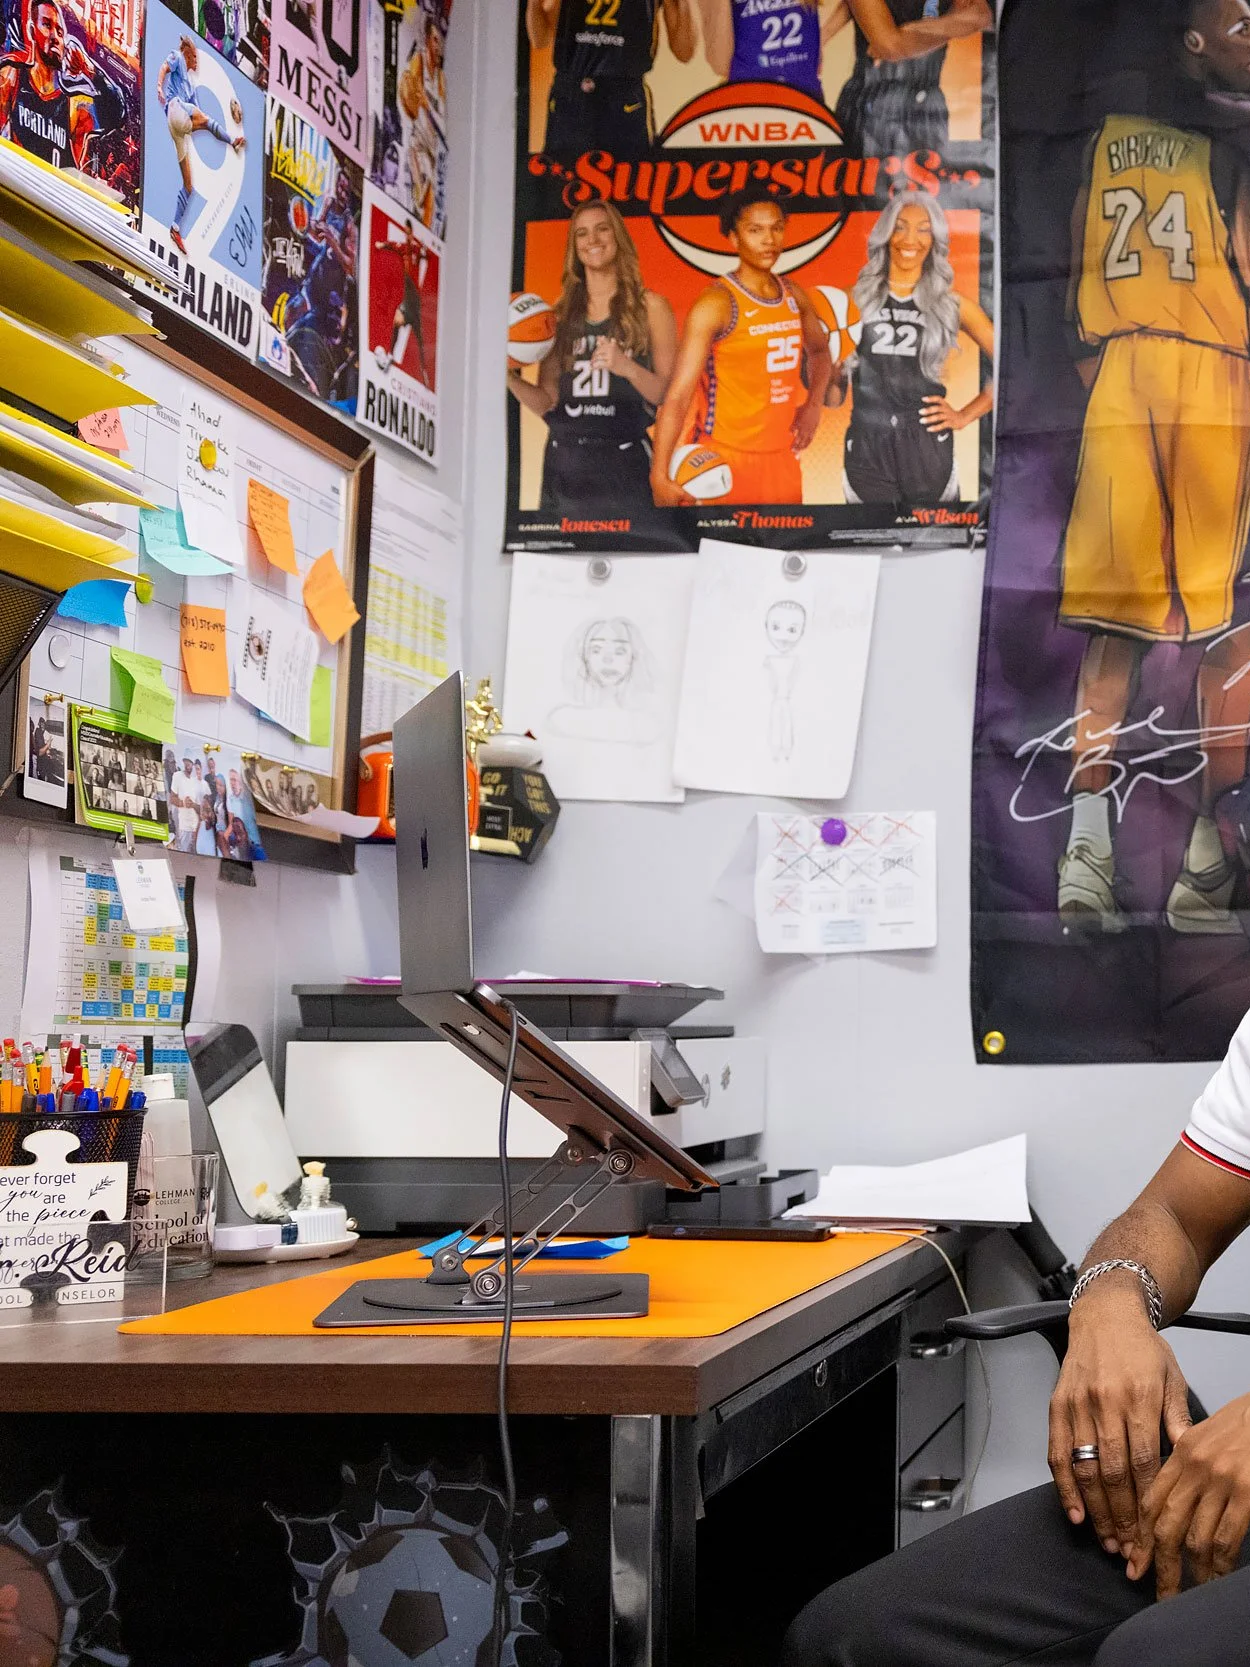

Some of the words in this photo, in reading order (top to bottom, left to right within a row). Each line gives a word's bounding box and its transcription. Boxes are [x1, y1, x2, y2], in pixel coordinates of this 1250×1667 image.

[584, 0, 619, 26] 22
[761, 12, 803, 51] 22
[277, 44, 362, 151] MESSI
[18, 104, 67, 150] PORTLAND
[699, 121, 817, 143] WNBA
[562, 149, 942, 216] Superstars
[1102, 187, 1196, 282] 24
[870, 322, 918, 357] 22
[766, 335, 800, 374] 25
[364, 379, 435, 457] RONALDO
[733, 510, 814, 529] Thomas
[912, 507, 980, 526] Wilson
[34, 1172, 77, 1187] forget
[0, 1189, 43, 1213] you
[43, 1192, 66, 1205] are
[155, 1188, 196, 1200] LEHMAN
[6, 1208, 30, 1223] the
[27, 1207, 91, 1237] piece
[133, 1211, 188, 1232] School
[192, 1209, 207, 1226] of
[14, 1231, 54, 1247] made
[58, 1230, 81, 1246] the
[133, 1229, 210, 1250] Education
[35, 1237, 142, 1283] Reid
